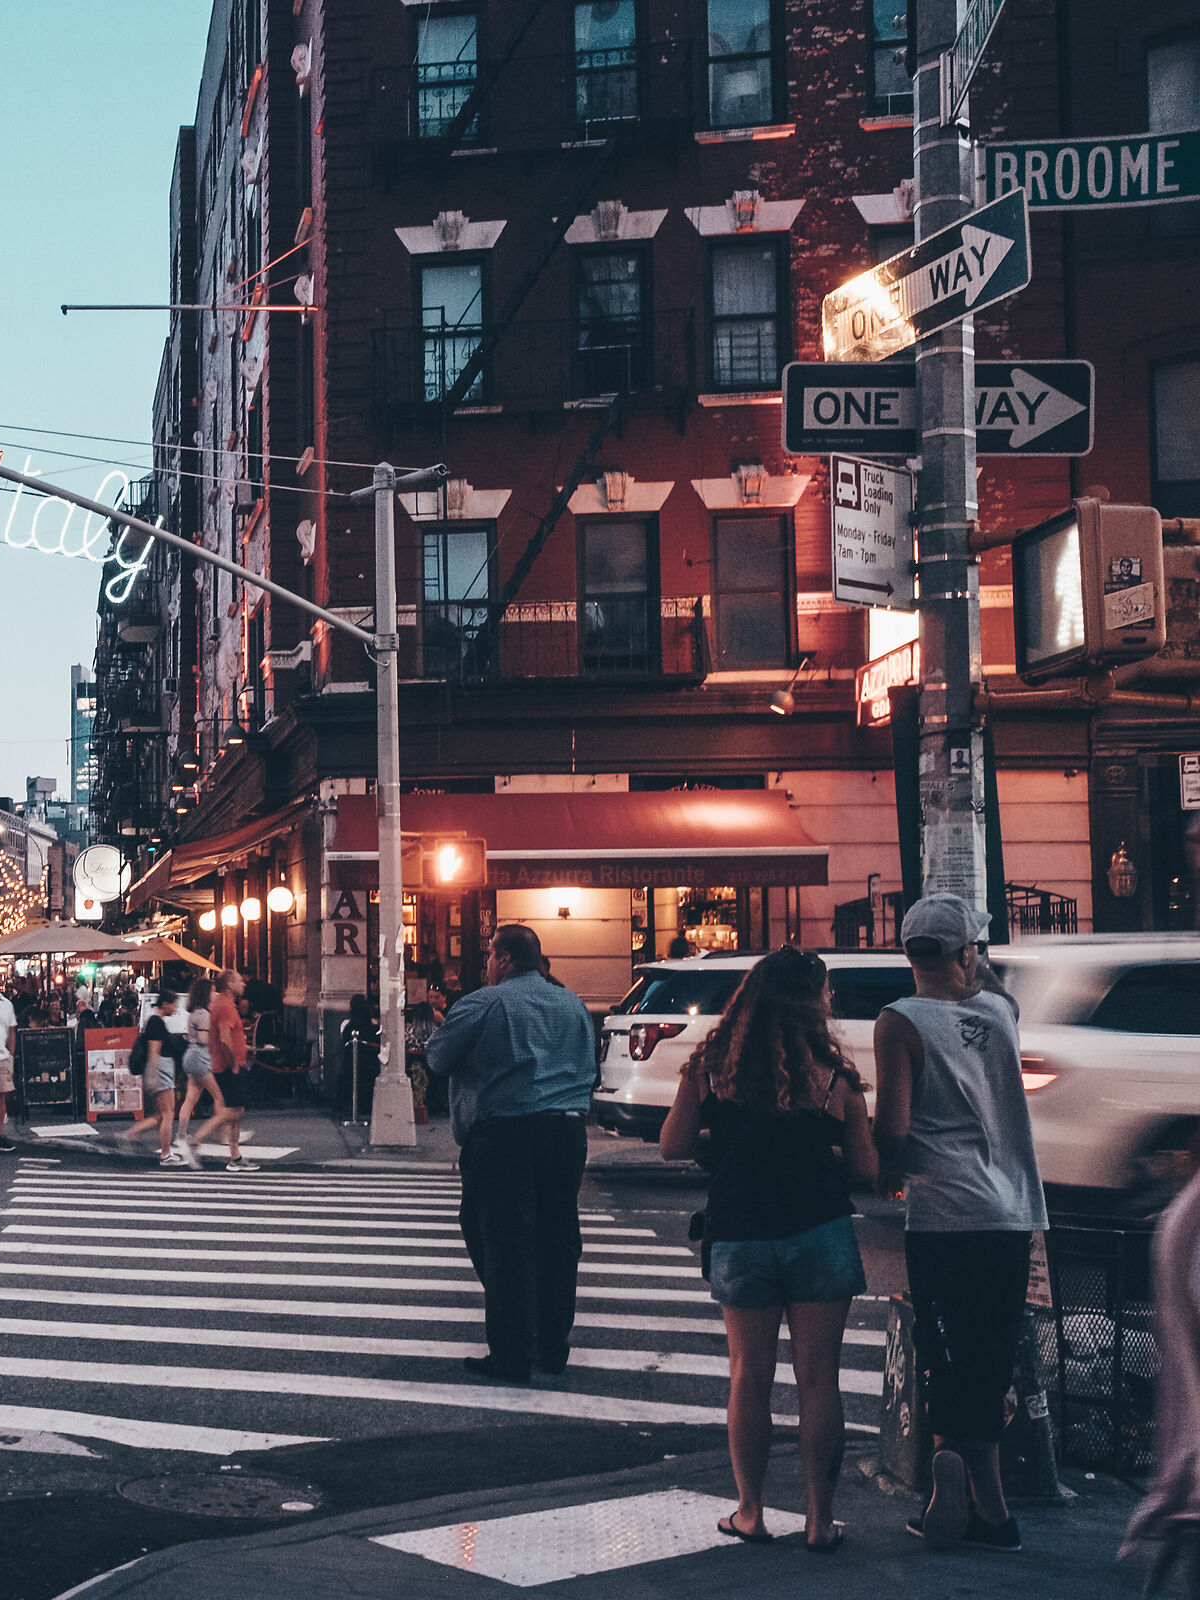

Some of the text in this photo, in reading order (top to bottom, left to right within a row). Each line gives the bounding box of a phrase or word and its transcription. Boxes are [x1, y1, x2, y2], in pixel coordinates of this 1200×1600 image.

[995, 140, 1180, 201] BROOME
[929, 237, 992, 300] WAY
[813, 391, 899, 425] ONE
[863, 468, 885, 485] Truck
[863, 484, 893, 505] Loading
[863, 500, 881, 517] Only
[837, 524, 866, 544] Monday
[873, 530, 896, 549] Friday
[838, 544, 854, 559] 7am
[860, 548, 877, 564] 7pm
[599, 864, 705, 884] Ristorante
